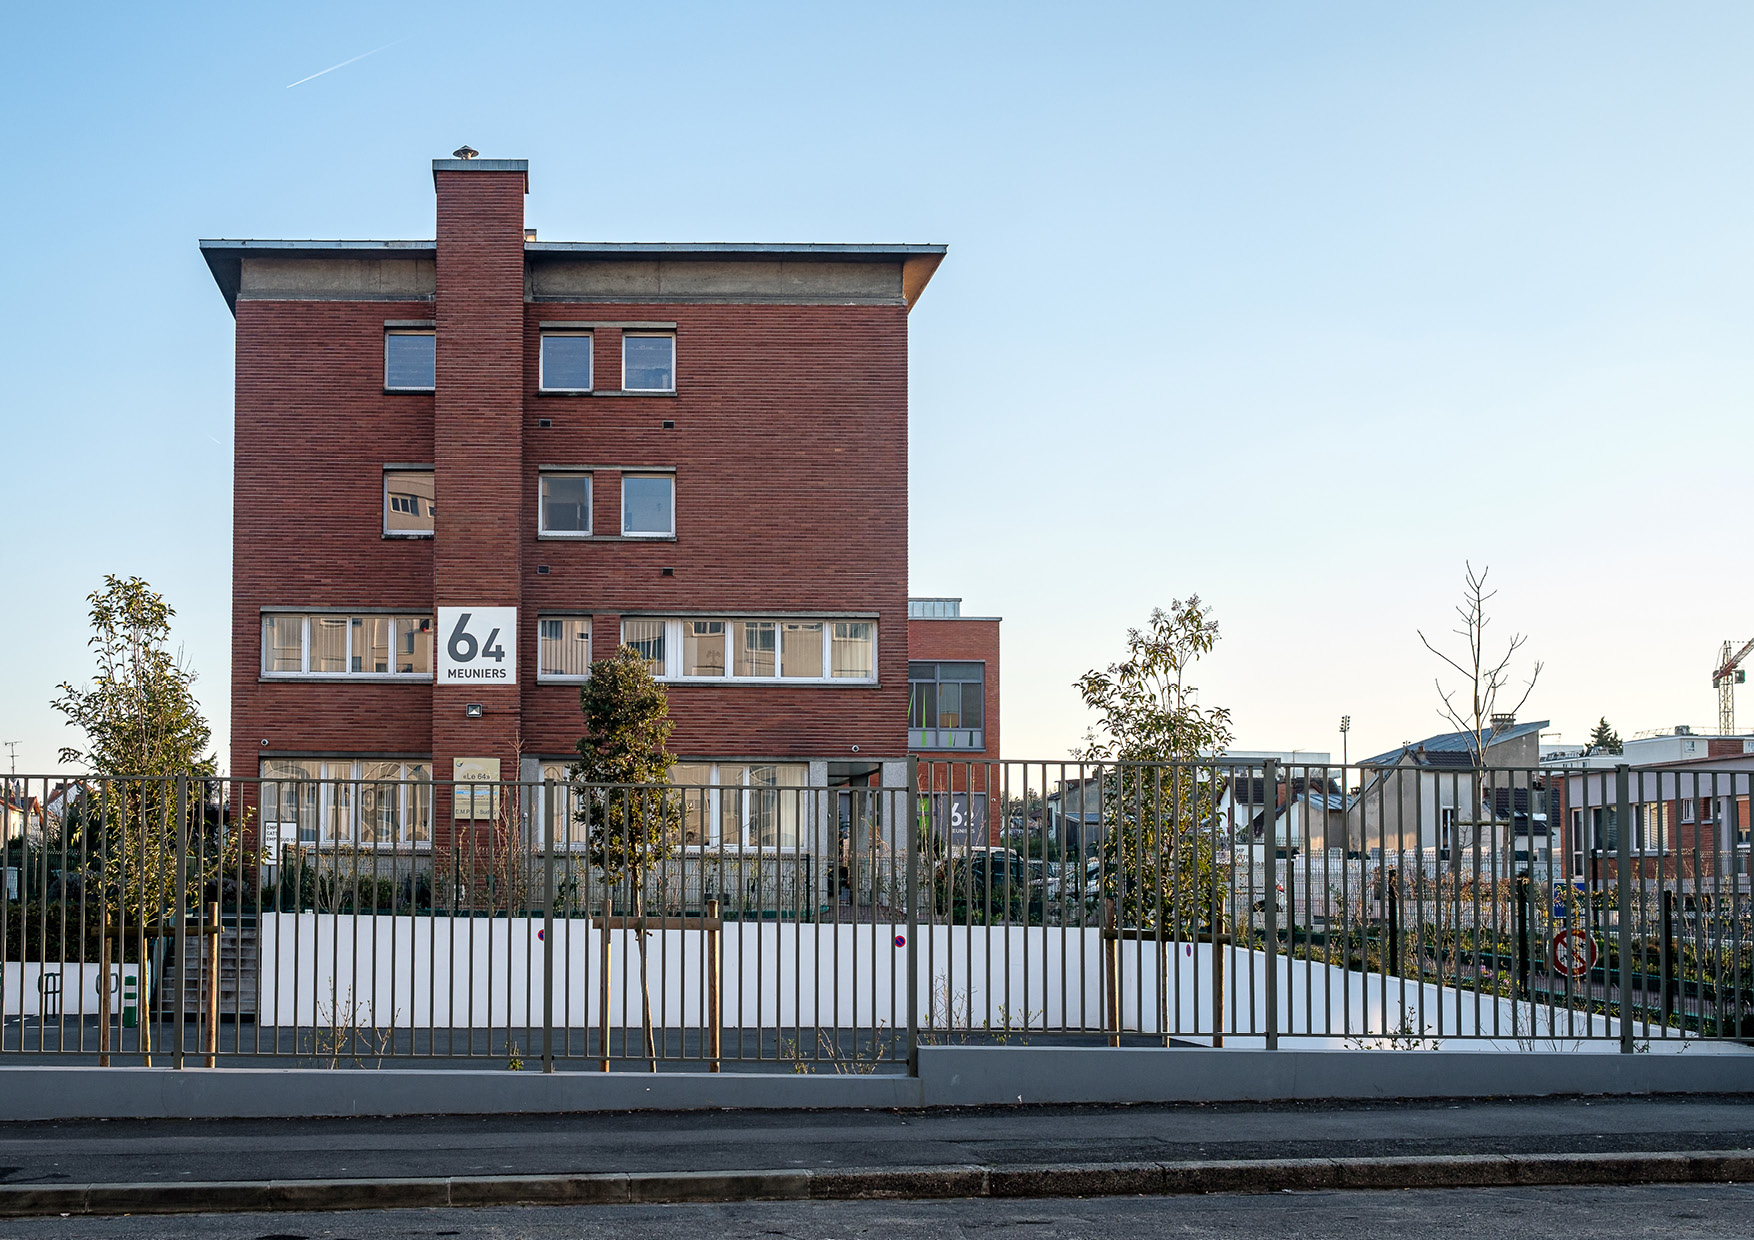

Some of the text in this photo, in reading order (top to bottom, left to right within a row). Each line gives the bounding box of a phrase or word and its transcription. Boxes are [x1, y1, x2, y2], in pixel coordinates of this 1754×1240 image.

[447, 613, 505, 663] 64
[447, 668, 507, 679] MEUNIERS
[950, 802, 975, 827] 62
